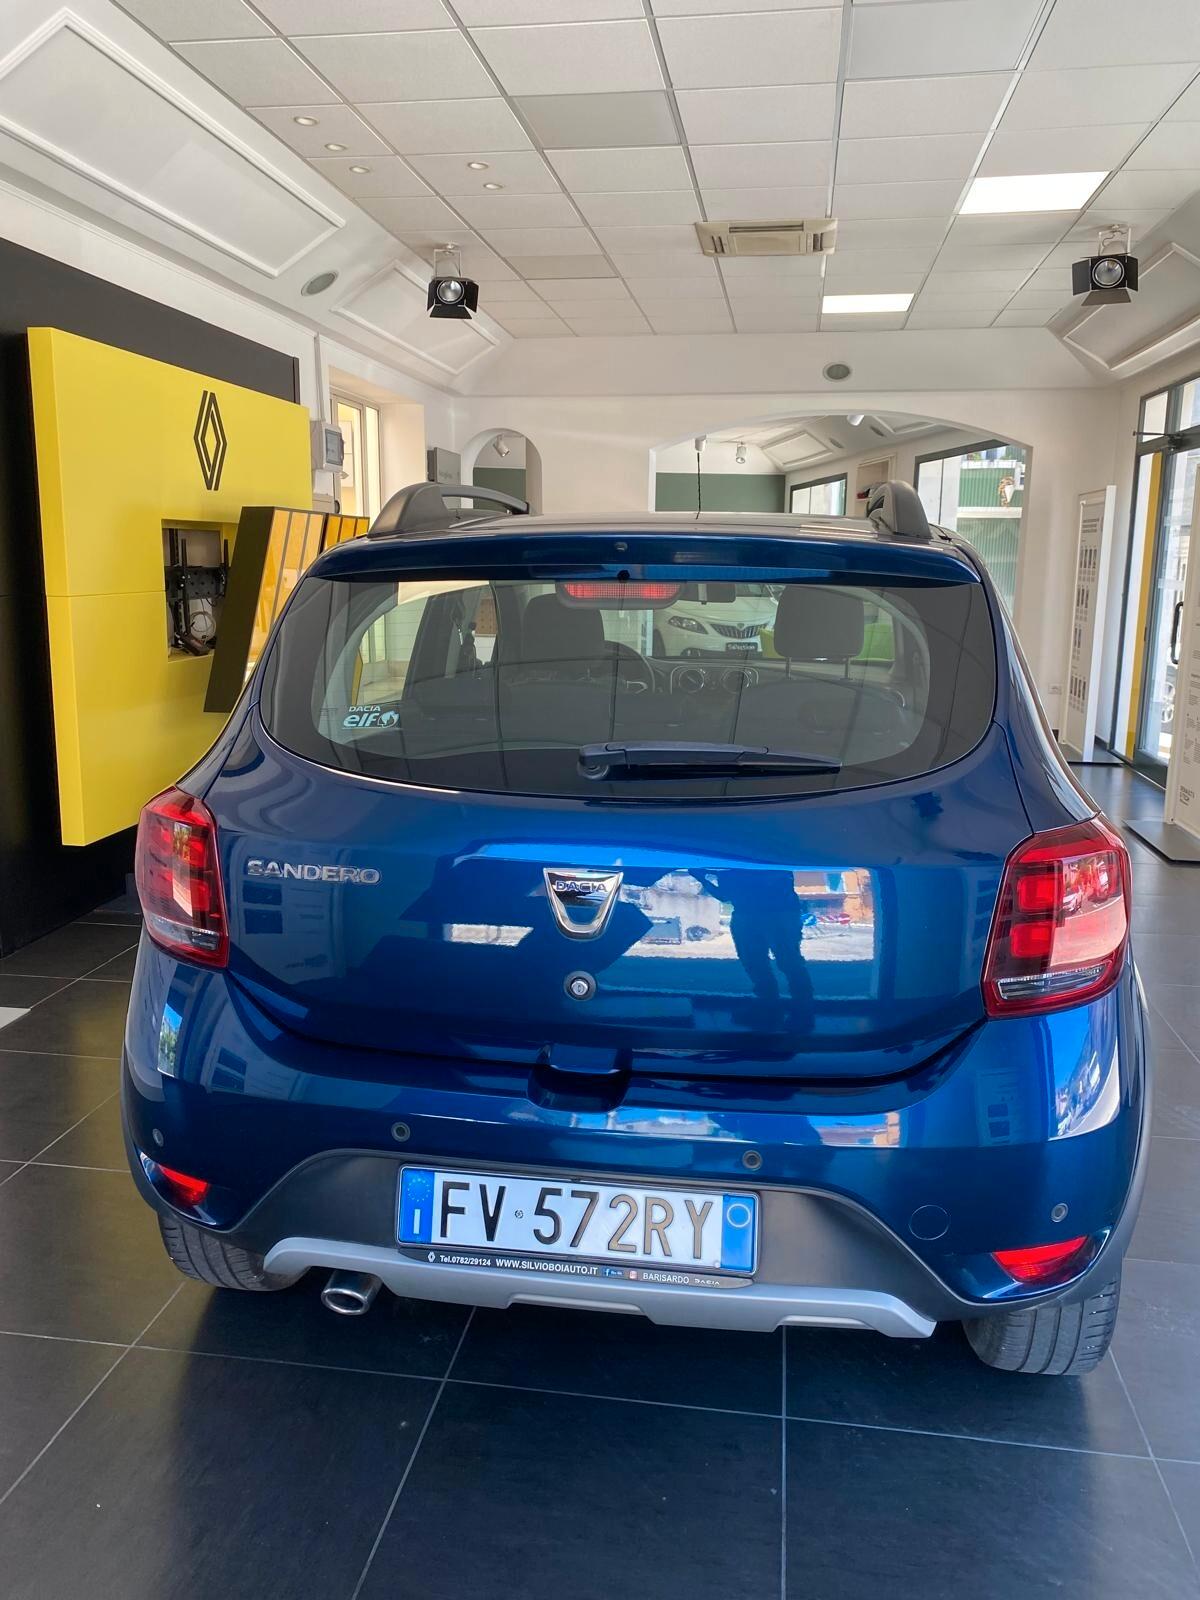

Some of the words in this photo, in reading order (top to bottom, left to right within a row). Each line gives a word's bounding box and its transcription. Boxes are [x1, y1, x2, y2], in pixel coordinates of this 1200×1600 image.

[343, 713, 379, 727] elf
[247, 859, 381, 884] SANDERO
[555, 880, 608, 892] DACIA
[440, 1180, 506, 1242] FV
[533, 1187, 714, 1259] 572RY
[440, 1255, 491, 1266] Tel.0782/29124
[496, 1258, 598, 1275] WWW.SILVIOBOIAUTO.IT
[643, 1272, 690, 1284] BARISARDO
